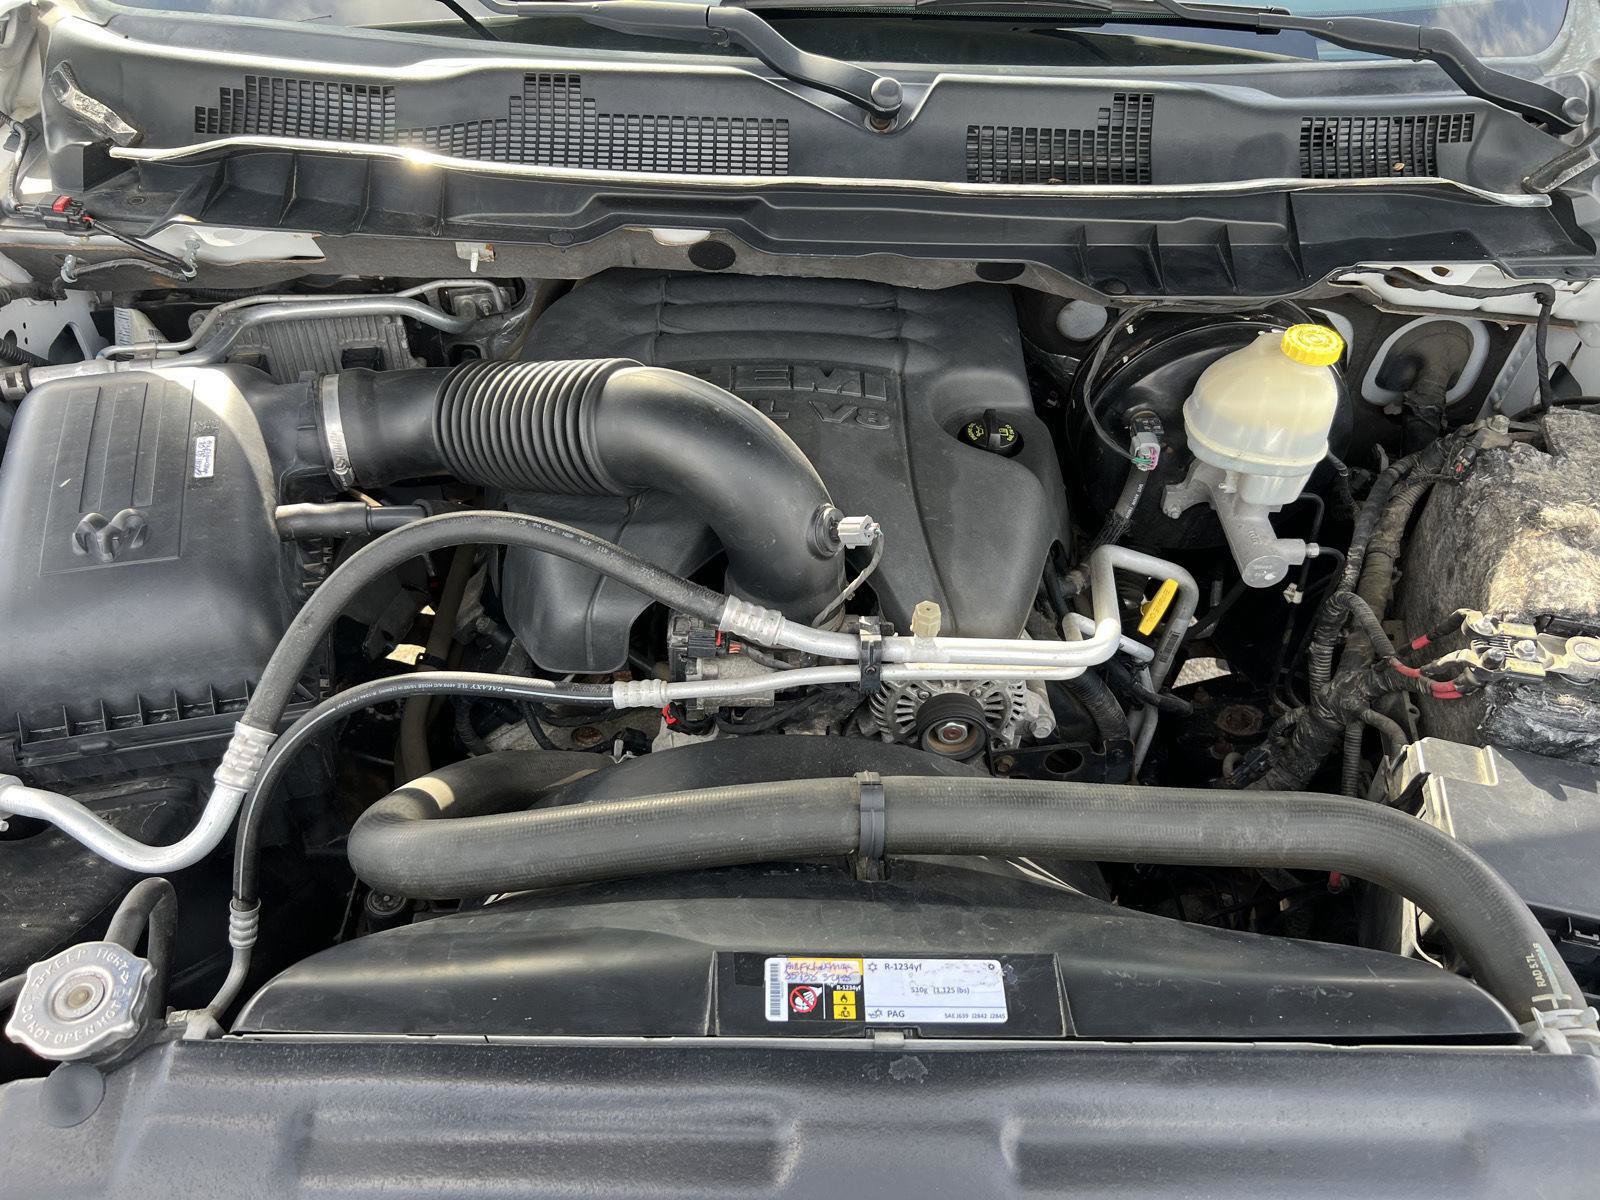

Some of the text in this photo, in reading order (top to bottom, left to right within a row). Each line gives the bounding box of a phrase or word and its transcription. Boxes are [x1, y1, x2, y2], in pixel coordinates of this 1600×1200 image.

[808, 399, 891, 430] V8
[469, 683, 504, 692] GALAXY
[884, 962, 923, 973] R-1234yf
[1532, 969, 1547, 988] RAD
[887, 1010, 905, 1018] PAG
[53, 1024, 96, 1045] OPEN
